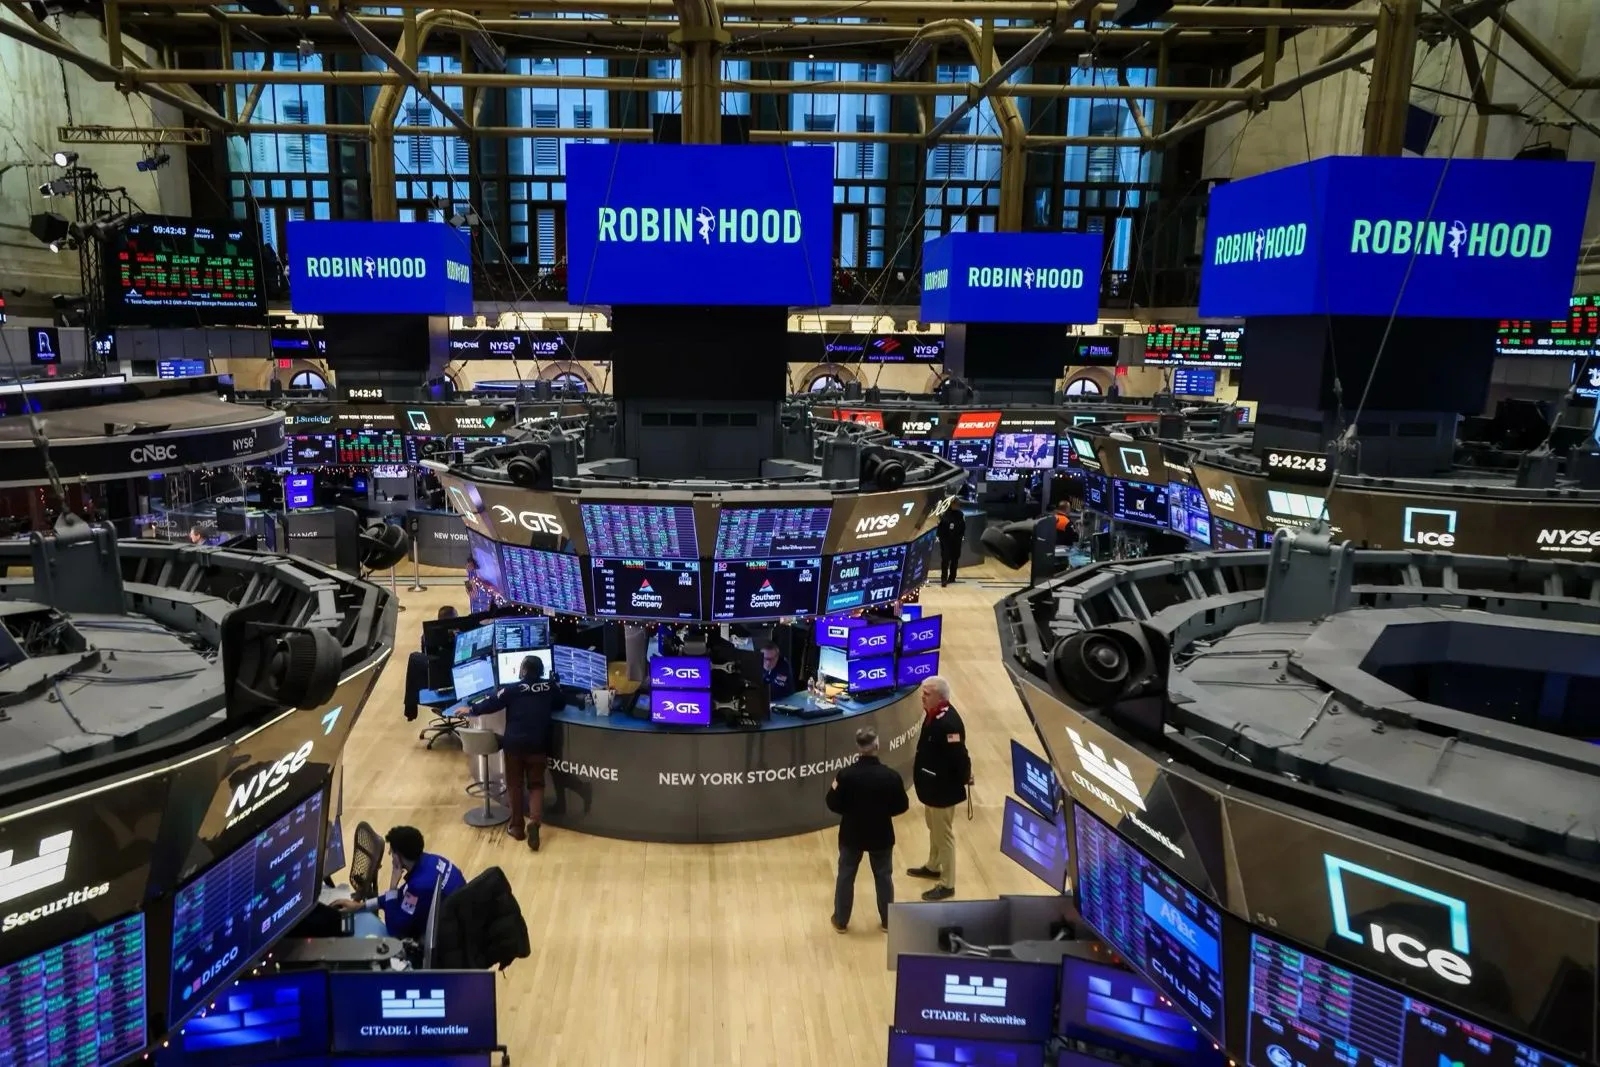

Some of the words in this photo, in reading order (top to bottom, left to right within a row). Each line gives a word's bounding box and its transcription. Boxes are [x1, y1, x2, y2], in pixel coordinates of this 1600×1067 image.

[153, 225, 187, 236] 09:42:43
[599, 207, 693, 242] ROBIN
[719, 208, 802, 244] HOOD
[1215, 231, 1255, 265] ROBIN
[1264, 223, 1307, 259] HOOD
[1350, 219, 1446, 255] ROBIN
[1467, 223, 1552, 258] HOOD
[307, 256, 364, 278] ROBIN
[377, 257, 426, 279] HOOD
[968, 266, 1022, 288] ROBIN
[1036, 268, 1084, 289] HOOD
[349, 389, 383, 398] 9:42:43
[455, 417, 482, 425] VIRTU
[130, 444, 177, 464] CNBC
[1268, 453, 1327, 472] 9:42:43
[519, 511, 563, 535] GTS
[839, 567, 860, 580] CAVA
[631, 592, 662, 602] Southern
[751, 593, 781, 601] Southern
[870, 586, 895, 601] YETI
[631, 600, 663, 609] Company
[750, 601, 781, 609] Company
[868, 635, 887, 646] GTS
[918, 629, 934, 641] GTS
[676, 668, 700, 679] GTS
[867, 668, 887, 680] GTS
[914, 663, 931, 675] GTS
[531, 682, 551, 692] GTS
[676, 703, 700, 714] GTS
[889, 732, 907, 752] NEW
[658, 771, 696, 786] NEW
[700, 771, 743, 786] YORK
[747, 766, 796, 785] STOCK
[800, 752, 863, 778] EXCHANG
[1071, 770, 1122, 814] CITADEL
[1129, 811, 1186, 860] Securities
[2, 881, 110, 932] Securities
[270, 891, 302, 923] TEREX
[1159, 901, 1197, 944] Aflac
[201, 945, 239, 986] DISCO
[1152, 957, 1215, 1020] CHUBB
[921, 1009, 970, 1022] CITADEL
[979, 1012, 1027, 1026] Securities
[360, 1025, 411, 1036] CITADEL
[421, 1024, 469, 1035] Securities
